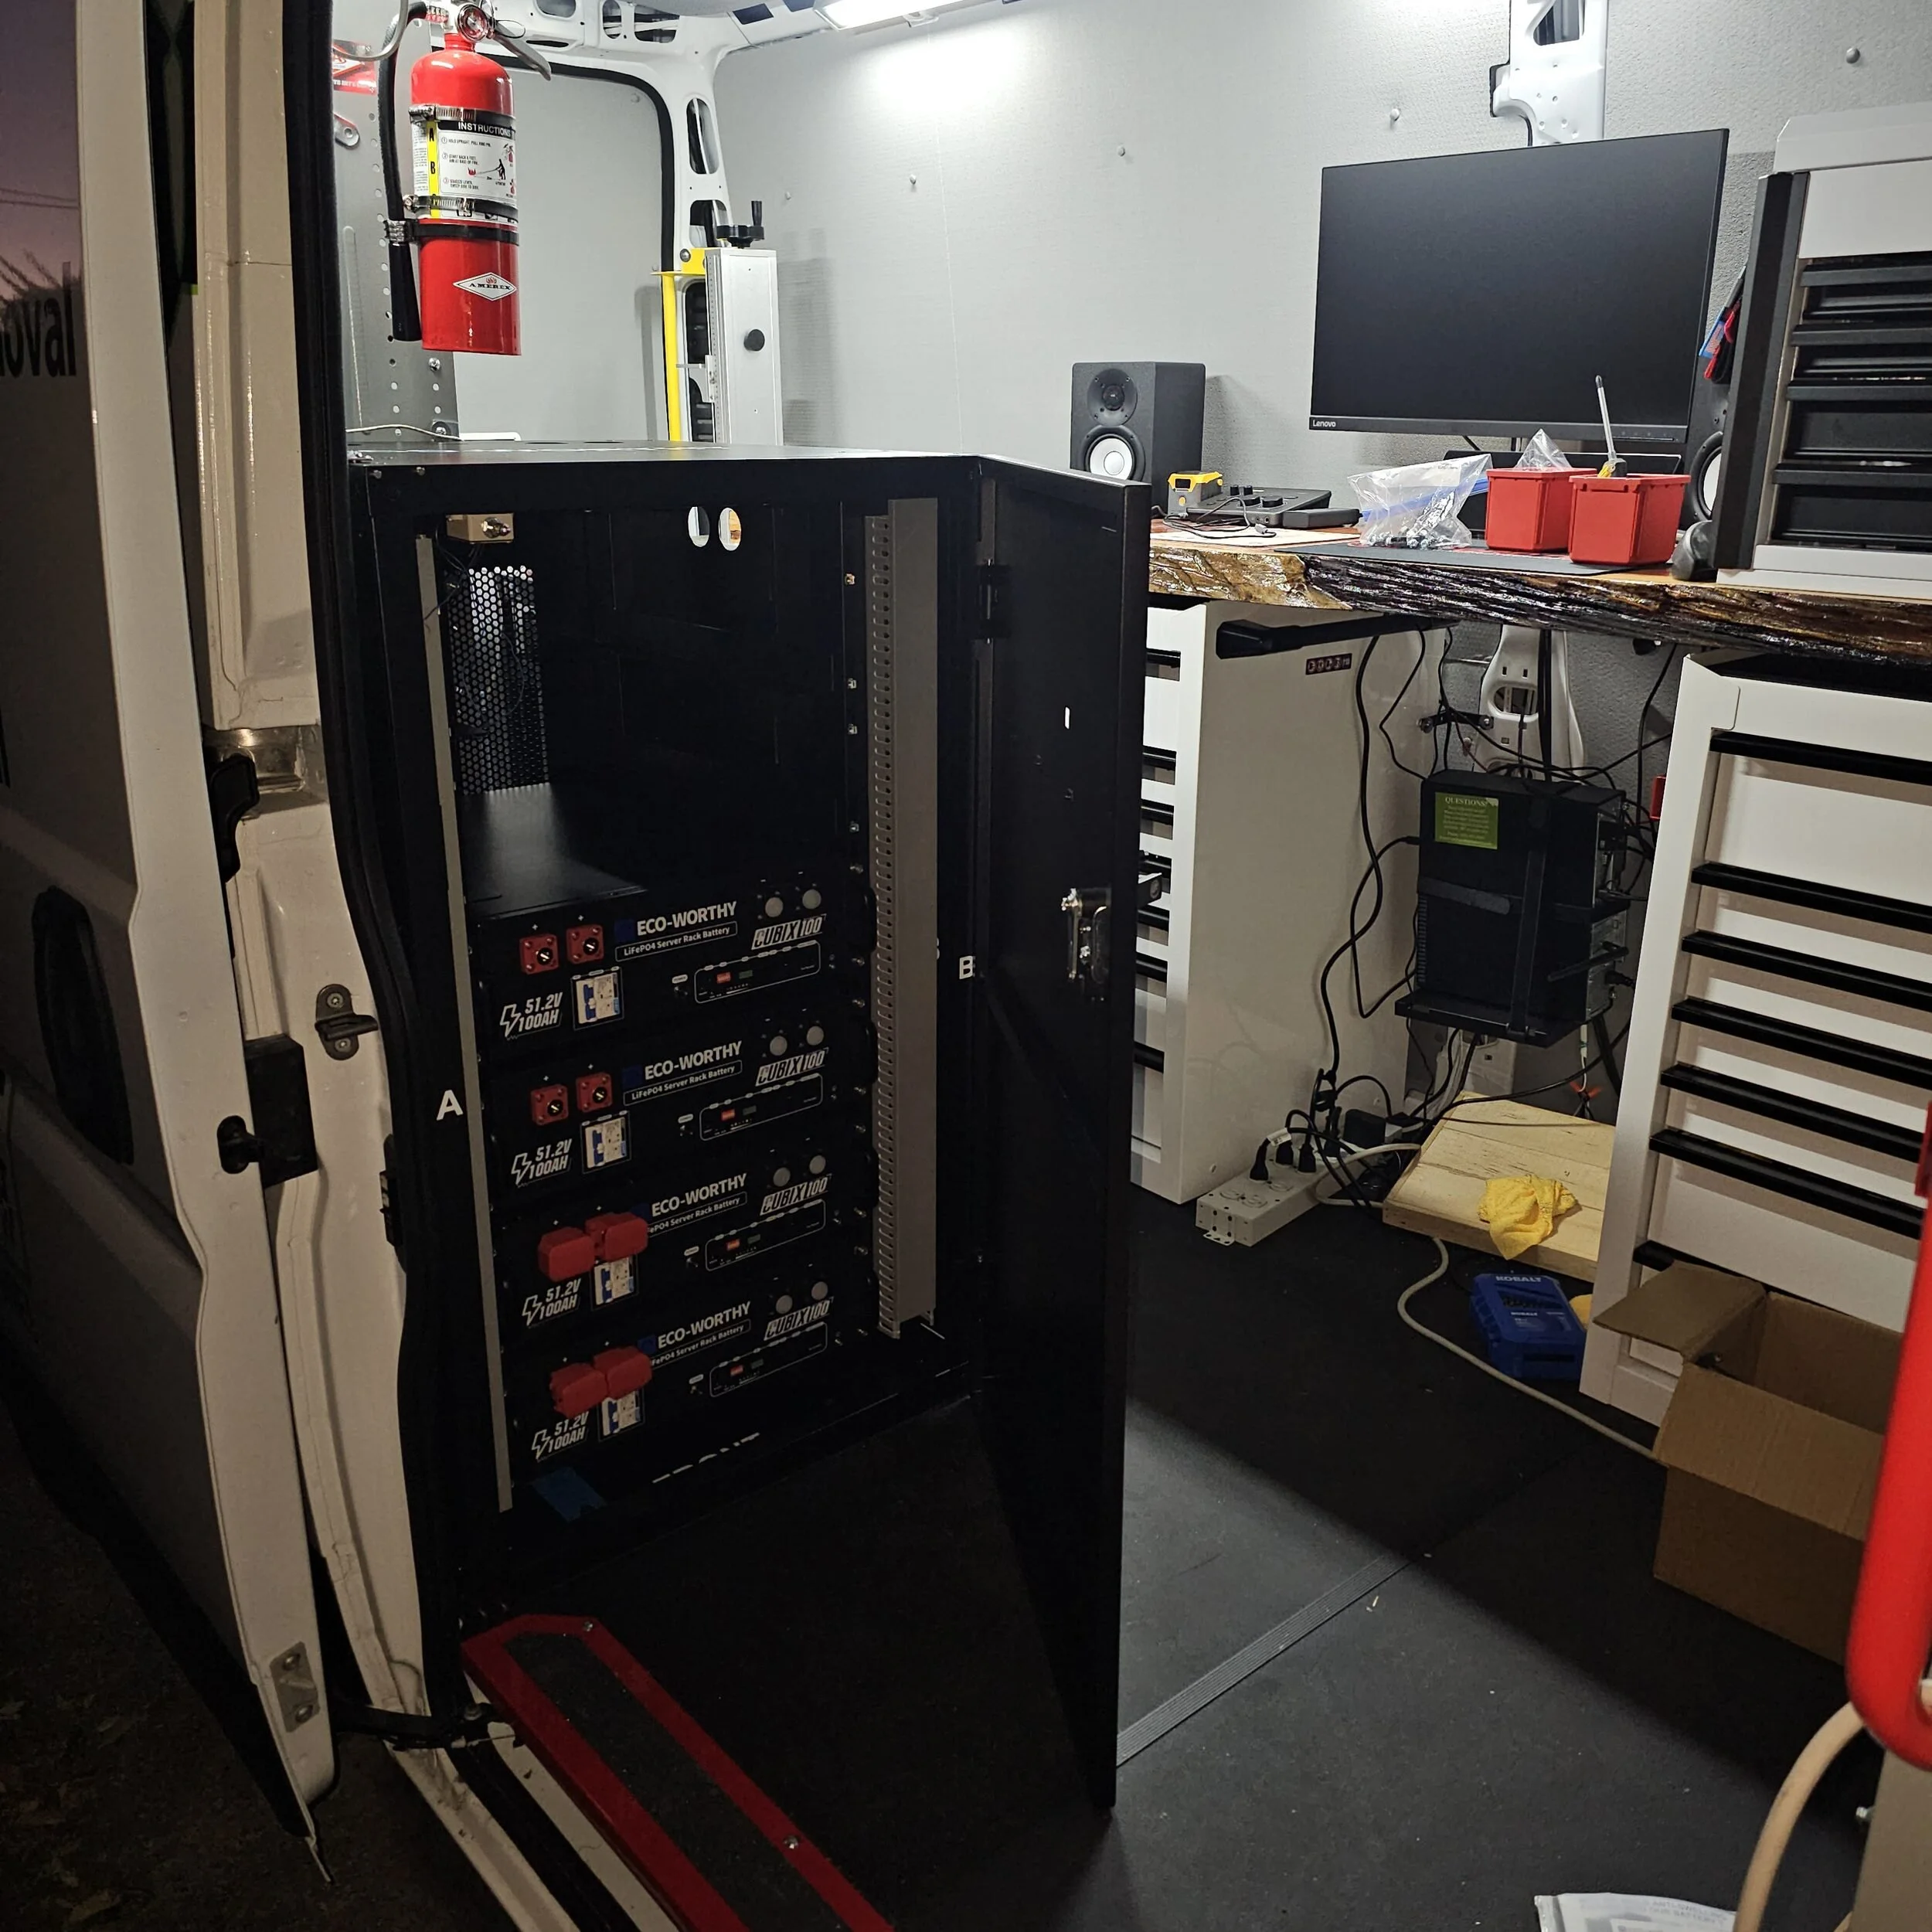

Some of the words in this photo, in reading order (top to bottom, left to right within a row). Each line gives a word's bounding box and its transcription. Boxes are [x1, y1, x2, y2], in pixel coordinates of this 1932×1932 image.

[429, 128, 435, 142] A
[458, 121, 511, 137] INSTRUCTIONS
[430, 162, 436, 174] B
[0, 262, 76, 377] oval
[637, 900, 737, 936] ECO-WORTHY
[624, 943, 655, 956] LiFePO4
[657, 937, 682, 948] Server
[683, 932, 702, 943] Rack
[702, 927, 730, 938] Battery
[959, 955, 975, 979] B
[524, 992, 563, 1014] 51.2V
[518, 1009, 560, 1032] 100AH
[645, 1039, 742, 1080] ECO-WORTHY
[631, 1087, 663, 1100] LiFePO4
[664, 1079, 688, 1090] Server
[689, 1073, 707, 1084] Rack
[708, 1066, 736, 1078] Battery
[436, 1090, 464, 1121] A
[535, 1138, 573, 1162] 51.2V
[529, 1155, 569, 1179] 100AH
[651, 1172, 747, 1216] ECO-WORTHY
[670, 1212, 694, 1225] Server
[696, 1206, 713, 1218] Rack
[714, 1198, 740, 1211] Battery
[545, 1277, 581, 1302] 51.2V
[539, 1294, 578, 1320] 100AH
[658, 1301, 750, 1349] ECO-WORTHY
[676, 1342, 699, 1356] Server
[699, 1335, 717, 1347] Rack
[718, 1325, 744, 1339] Battery
[554, 1410, 590, 1436] 51.2V
[547, 1425, 587, 1453] 100AH
